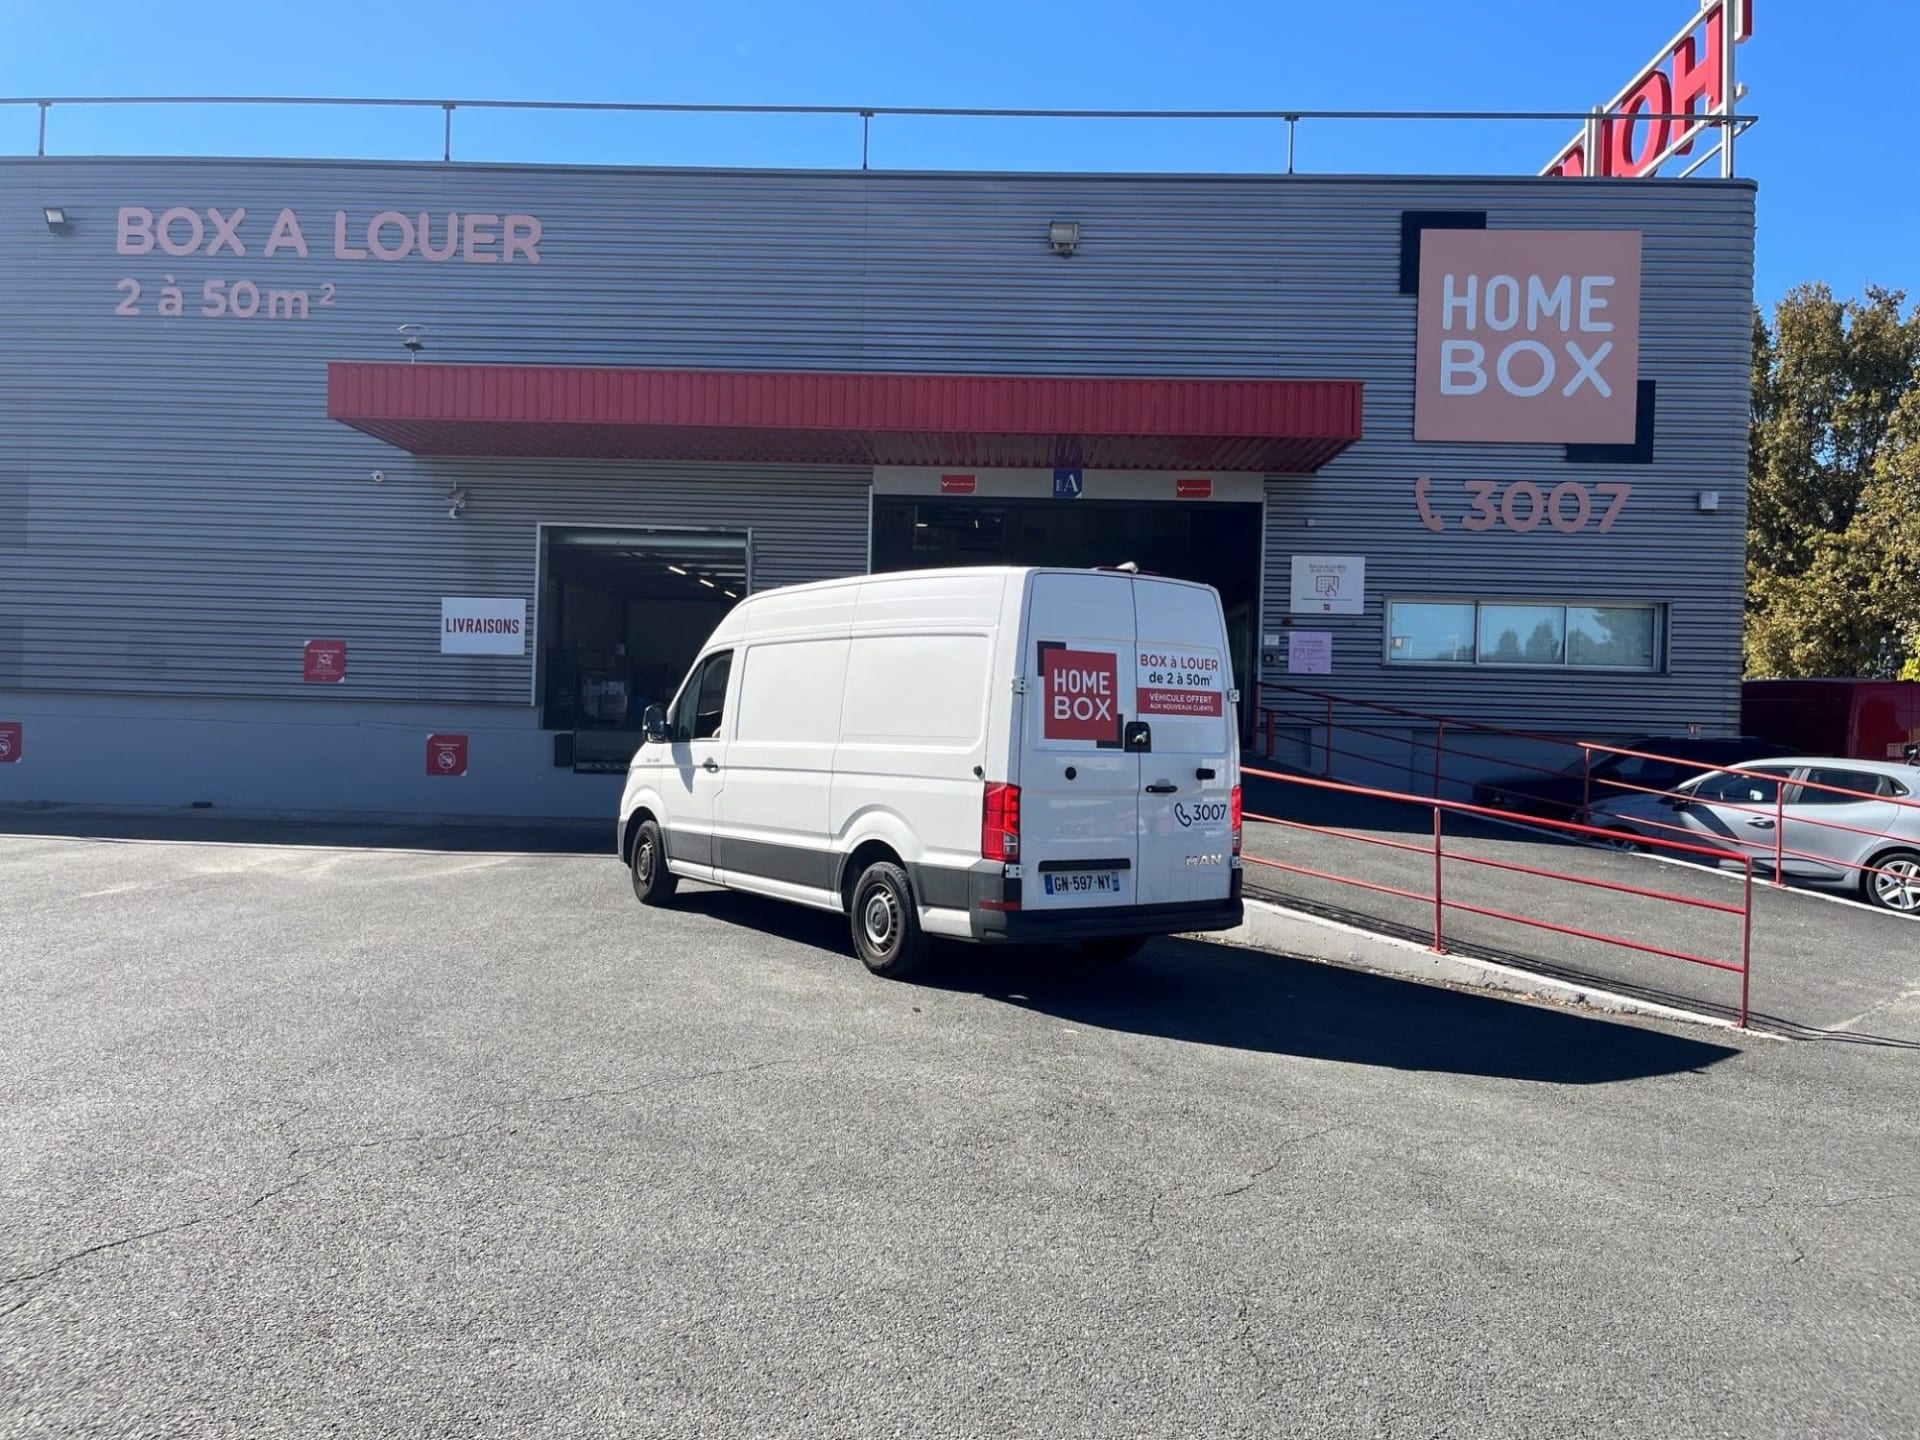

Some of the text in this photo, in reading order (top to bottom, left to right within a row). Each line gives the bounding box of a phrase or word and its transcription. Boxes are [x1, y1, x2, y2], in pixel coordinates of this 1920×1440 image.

[117, 206, 542, 265] BOX A LOUER
[115, 279, 141, 316] 2
[158, 274, 183, 317] à
[1442, 273, 1617, 334] HOME
[1439, 339, 1613, 399] BOX
[1461, 480, 1632, 535] 3007
[445, 617, 520, 635] LIVRAISONS
[1140, 654, 1218, 671] BOX à LOUER
[1053, 668, 1112, 696] HOME
[1149, 671, 1164, 684] de
[1167, 672, 1174, 684] 2
[1177, 672, 1183, 685] à
[1053, 696, 1112, 722] BOX
[1149, 692, 1213, 704] VÉHICULE OFFERT
[1193, 804, 1227, 821] 3007
[1054, 874, 1111, 892] GN-597-NY
